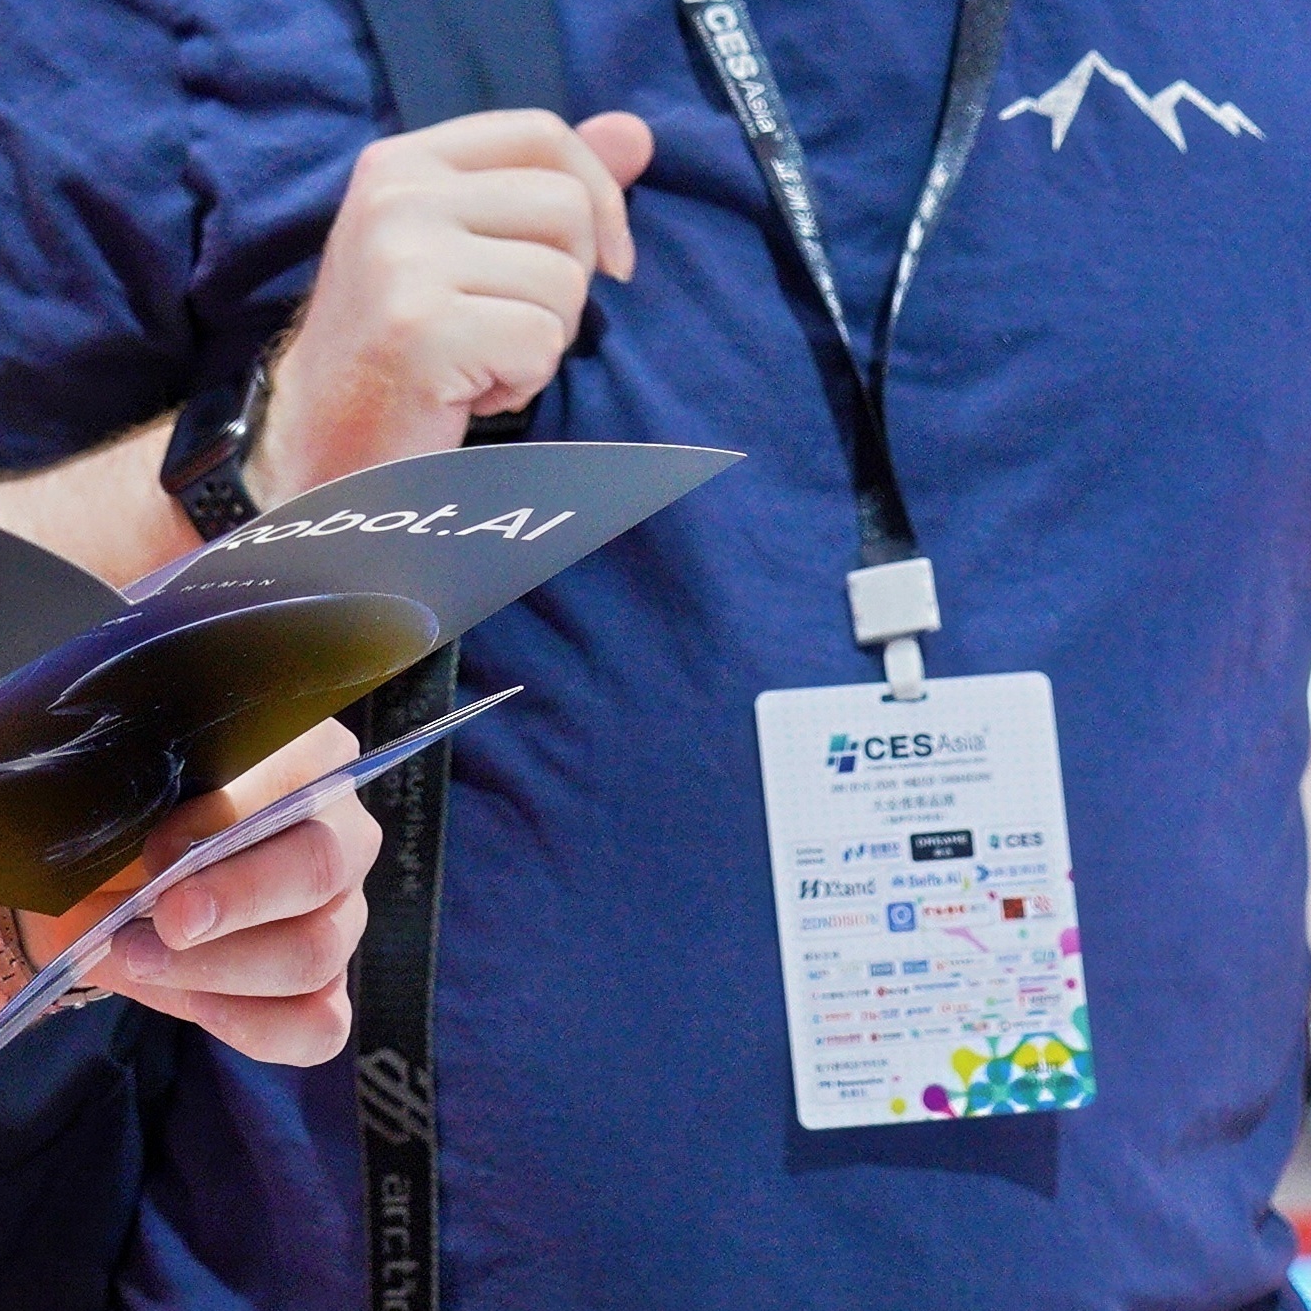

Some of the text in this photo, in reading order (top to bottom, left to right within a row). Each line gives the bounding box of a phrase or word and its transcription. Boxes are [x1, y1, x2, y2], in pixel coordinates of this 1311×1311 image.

[704, 1, 778, 135] CES Asia
[180, 578, 277, 594] HUMAN
[864, 731, 987, 762] CES Asia
